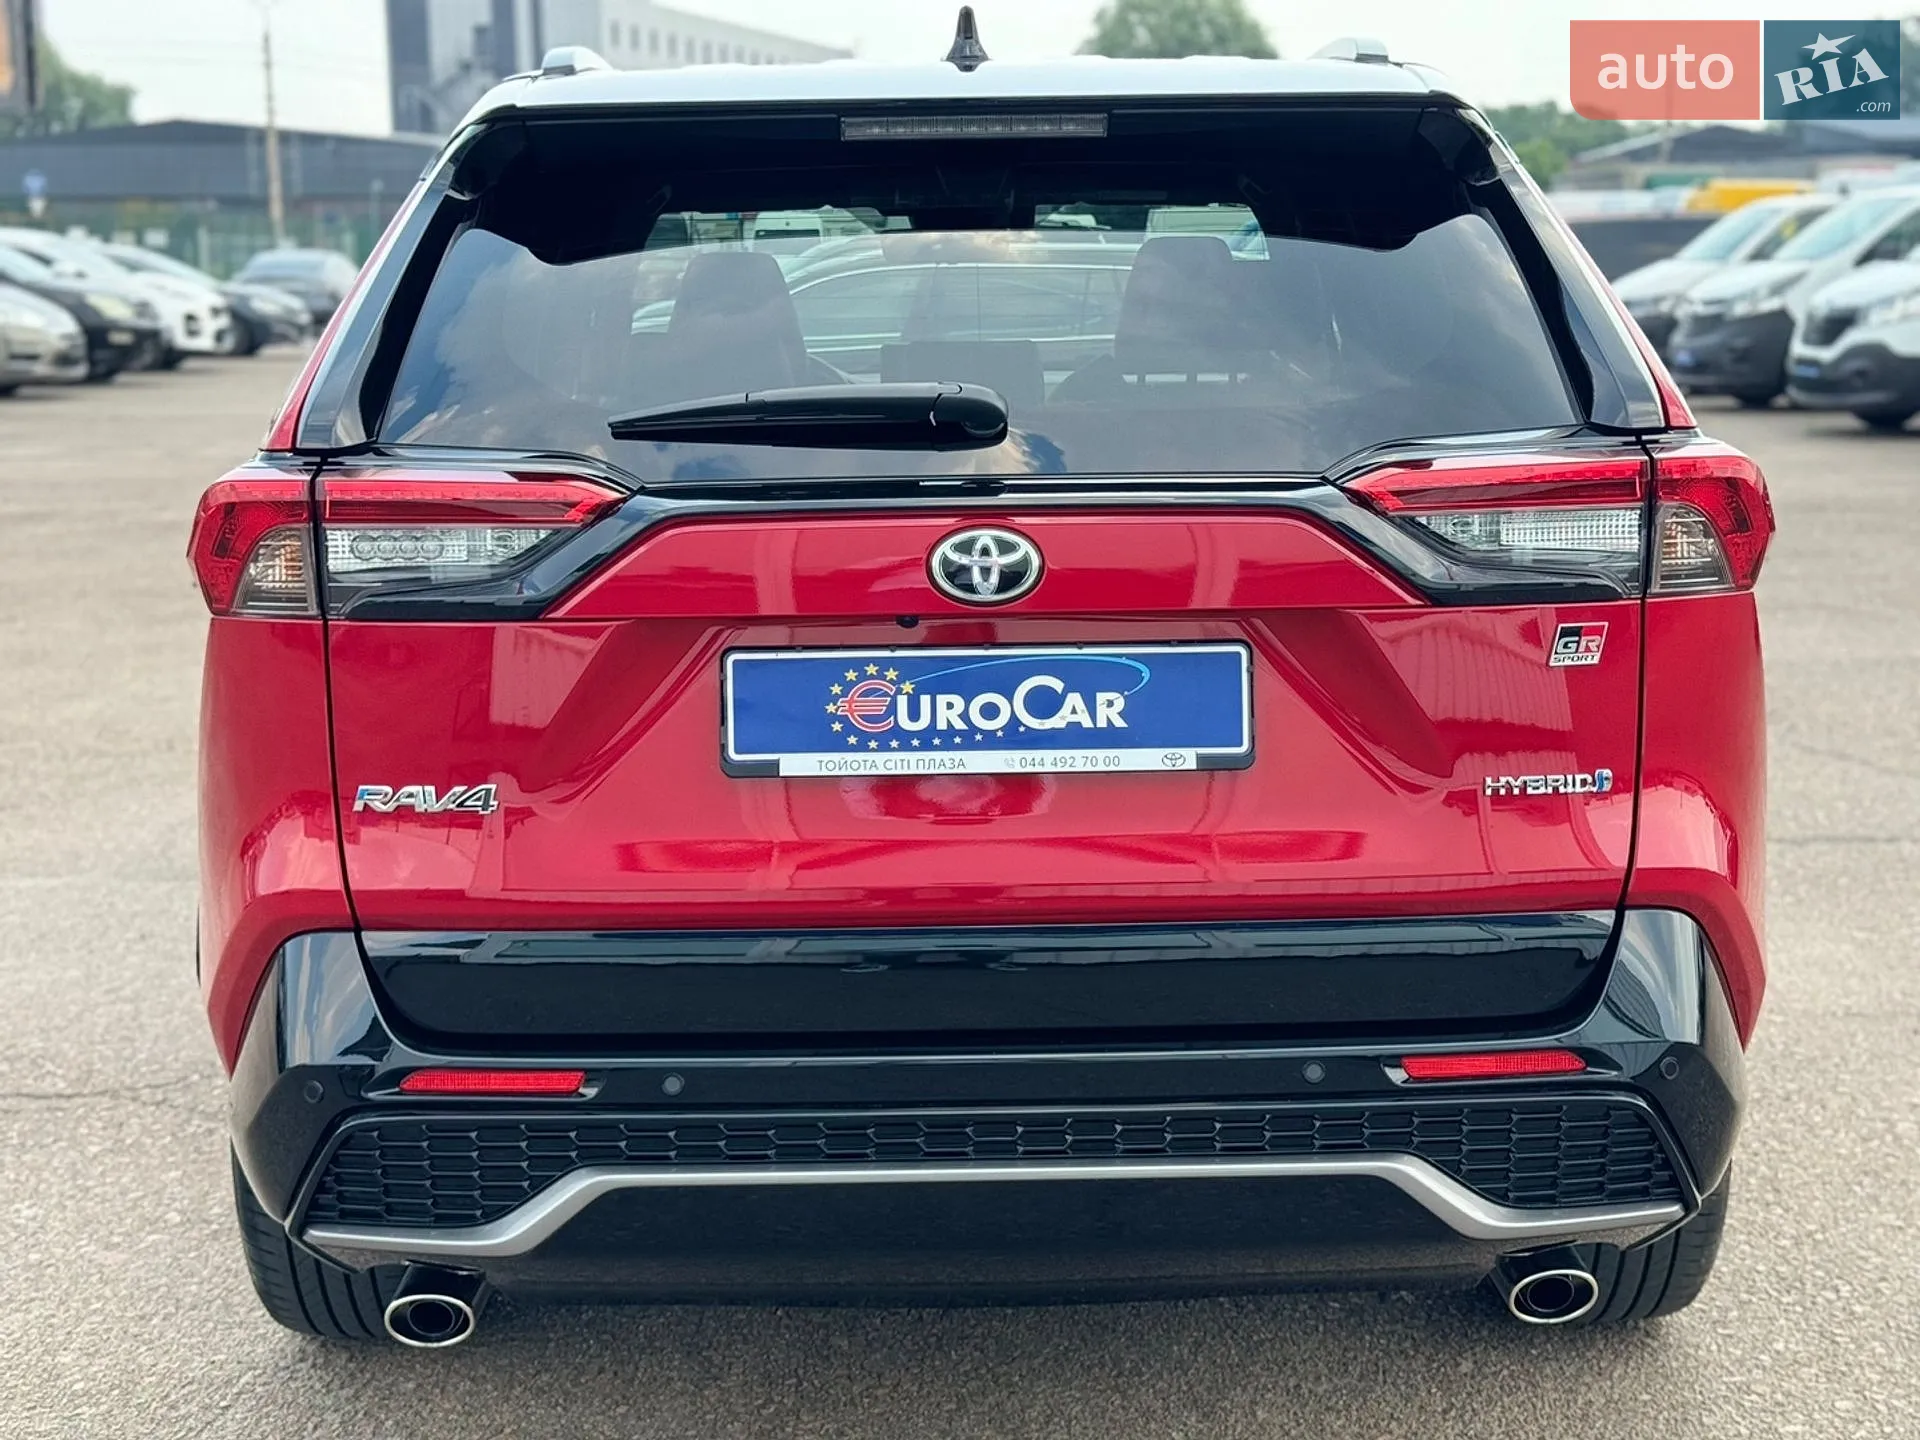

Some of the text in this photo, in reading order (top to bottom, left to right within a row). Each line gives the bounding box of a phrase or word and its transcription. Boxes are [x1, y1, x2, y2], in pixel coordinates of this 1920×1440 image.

[1556, 635, 1602, 653] GR
[1552, 654, 1596, 664] SPORT
[816, 757, 879, 771] ТОЙОТА
[915, 758, 967, 770] ПЛАЗА
[1019, 755, 1121, 769] 044 492 70 00
[1485, 773, 1596, 796] HYBRID
[352, 783, 500, 815] RAV4
